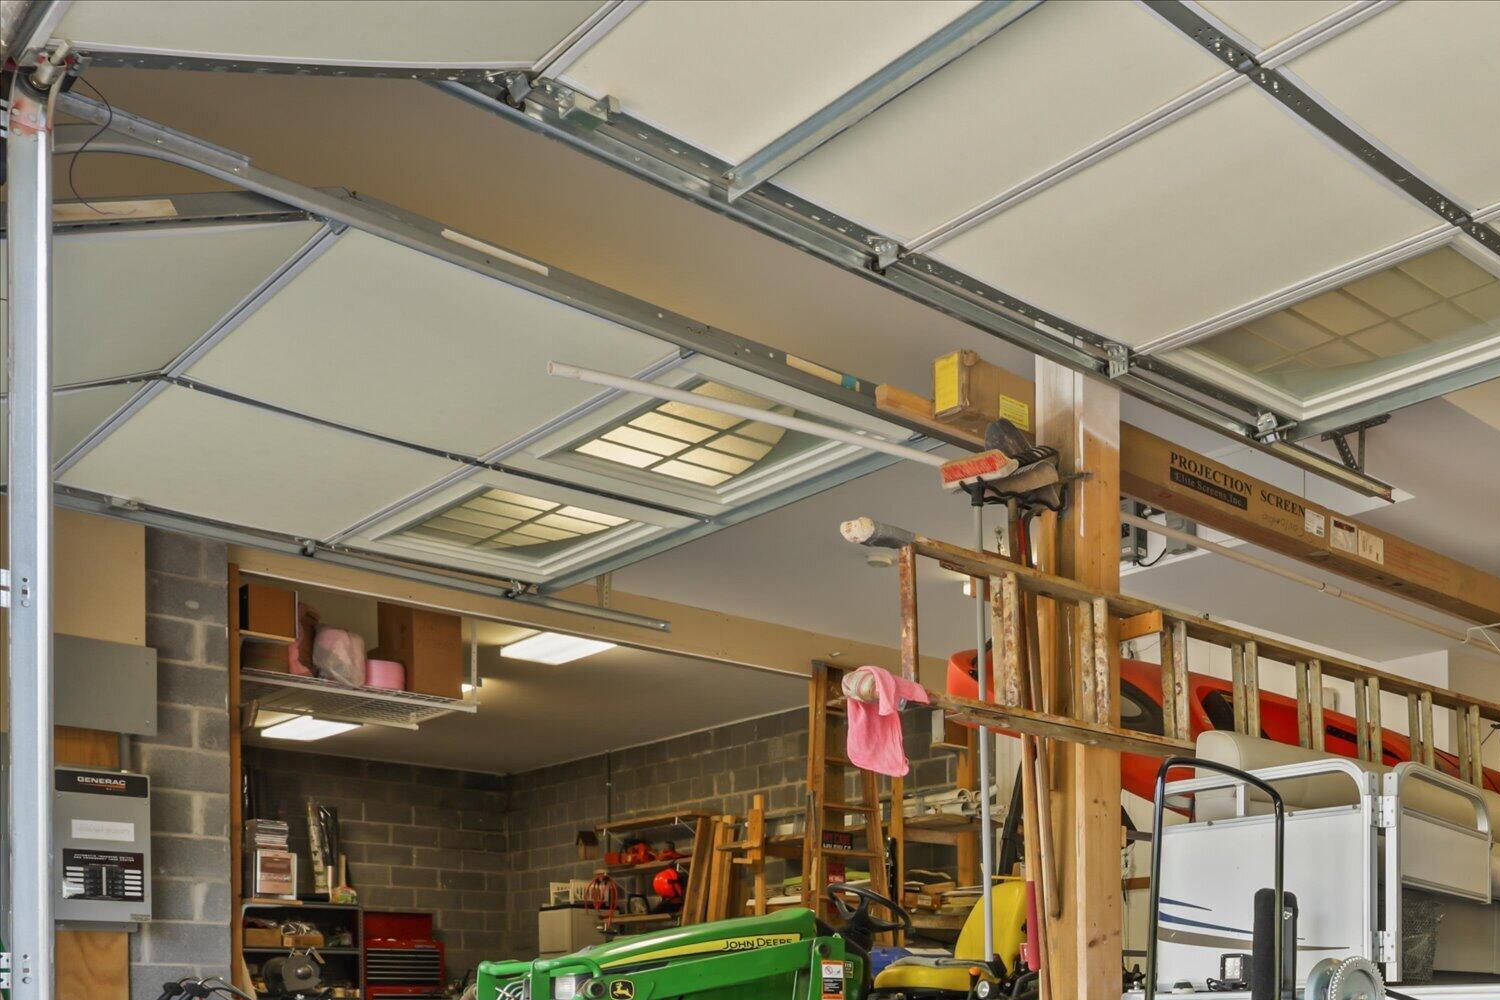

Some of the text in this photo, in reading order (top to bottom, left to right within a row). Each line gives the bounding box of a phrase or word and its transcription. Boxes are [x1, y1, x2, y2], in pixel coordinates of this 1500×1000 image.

[1170, 451, 1305, 518] PROJECTION SCREEN
[77, 776, 126, 786] GENERAC
[722, 940, 754, 950] JOHN
